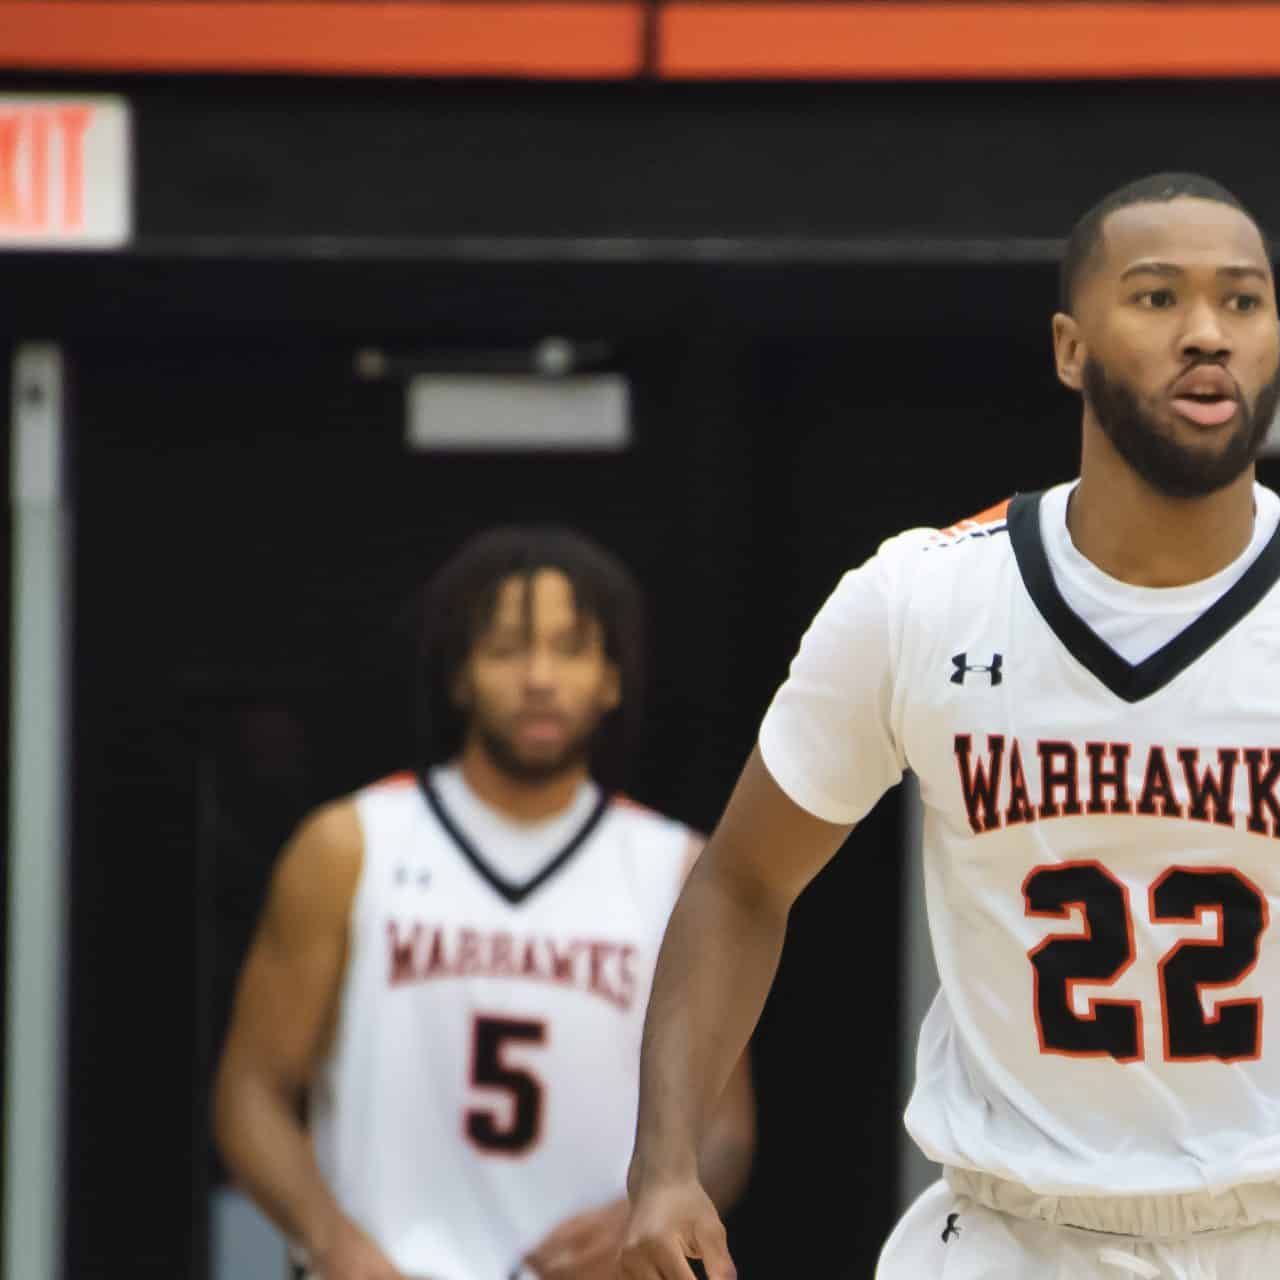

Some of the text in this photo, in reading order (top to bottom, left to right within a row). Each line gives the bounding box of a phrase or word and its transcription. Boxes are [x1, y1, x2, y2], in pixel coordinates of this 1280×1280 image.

[386, 918, 636, 1012] WARHAWKS
[1021, 859, 1270, 1065] 22
[463, 1010, 548, 1159] 5
